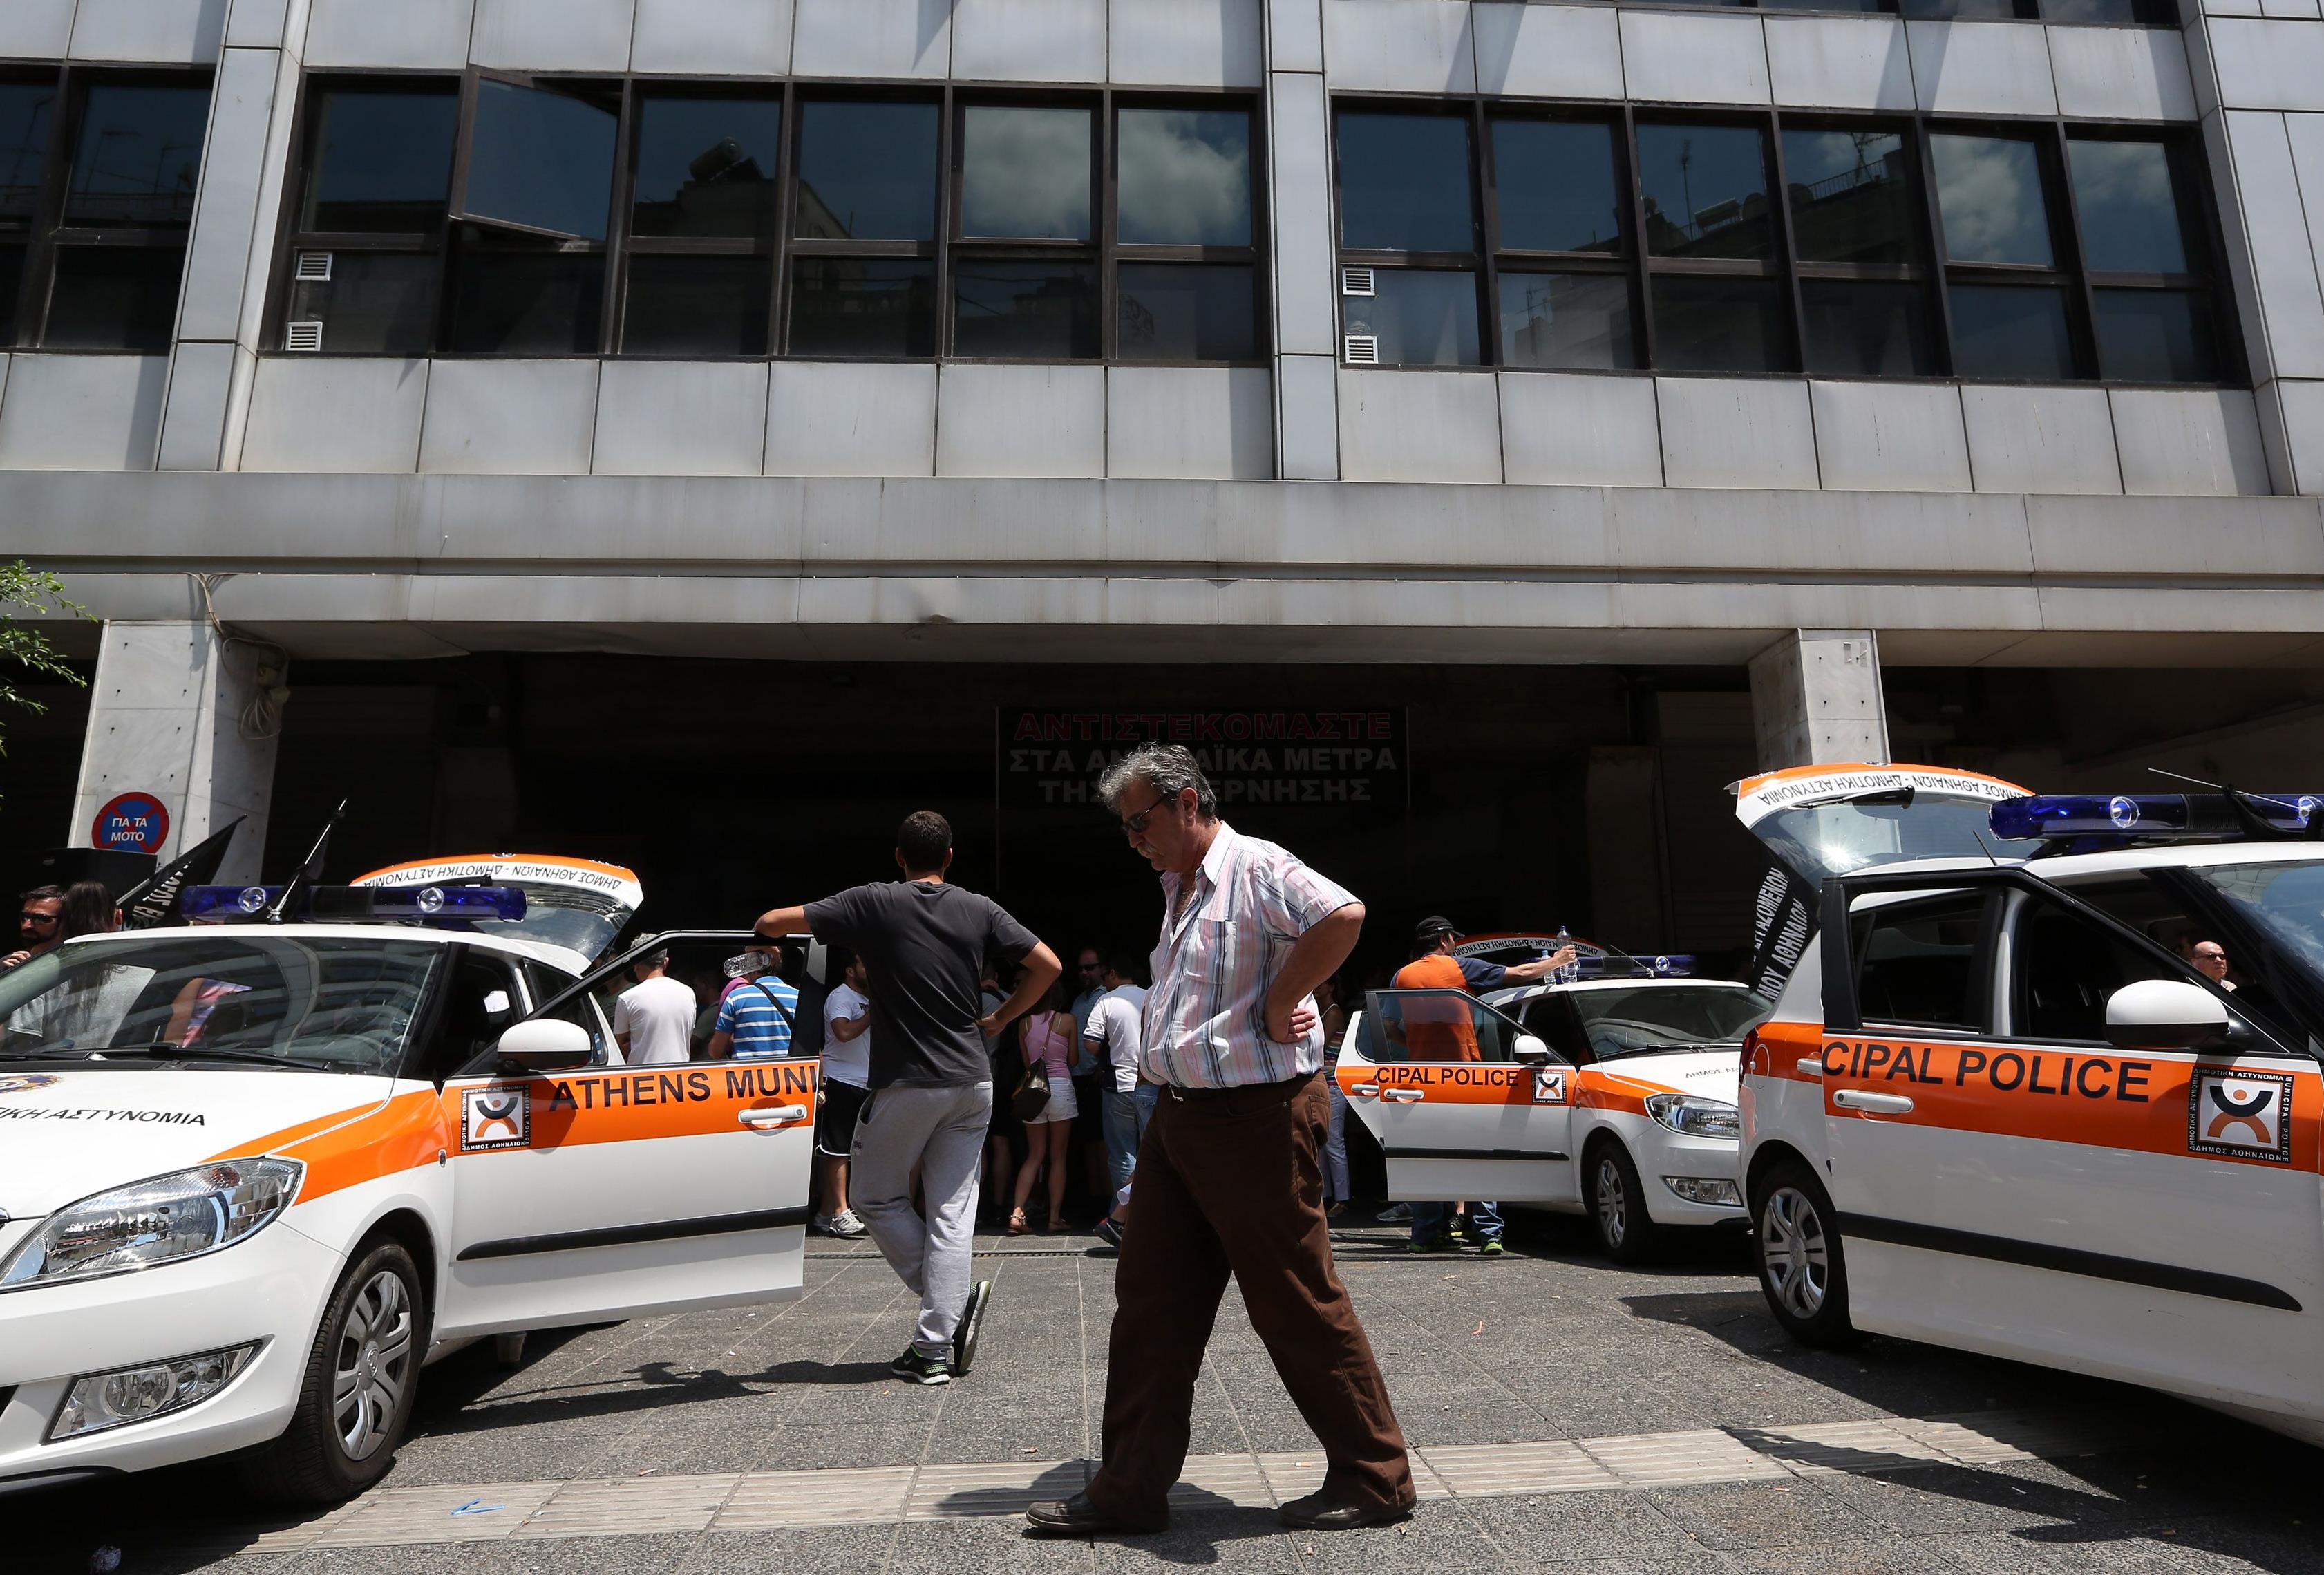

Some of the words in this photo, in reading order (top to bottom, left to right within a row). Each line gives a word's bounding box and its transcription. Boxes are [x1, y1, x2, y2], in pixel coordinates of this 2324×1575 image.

[1013, 713, 1392, 741] ΑΝΤΙΣΤΕΚΟΜΑΣΤΕ
[1010, 749, 1075, 772] ΣΤΑ
[1283, 748, 1397, 771] ΜΕΤΡΑ
[1757, 778, 1833, 805] ΑΣΤΥΝΟΜΙΑ
[1833, 775, 1902, 790] ΔΗΜΟΤΙΚΗ
[1912, 775, 1979, 793] ΑΘΗΝΑΙΩΝ
[112, 818, 129, 827] ΓΙΑ
[133, 818, 147, 827] ΤΑ
[111, 831, 144, 841] ΜΟΤΟ
[437, 865, 503, 877] ΔΗΜΟΤΙΚΗ
[512, 865, 578, 880] ΑΘΗΝΑΙΩΝ
[578, 871, 622, 889] ΔΗΜΟΣ
[1770, 898, 1808, 969] ΑΘΗΝΑΙΩΝ
[1491, 939, 1529, 949] ΔΗΜΟΤΙΚΗ
[1377, 1066, 1436, 1084] CIPAL
[1441, 1068, 1519, 1086] POLICE
[1822, 1041, 1943, 1084] CIPAL
[1956, 1050, 2153, 1103] POLICE
[2193, 1068, 2233, 1077] ΔΗΜΟΤΙΚΗ
[2237, 1073, 2284, 1082] ΑΣΤΥΝΟΜΙΑ
[549, 1073, 711, 1112] ATHENS
[726, 1066, 817, 1099] MUNI
[2190, 1073, 2199, 1111] ΑΣΤΥΝΟΜΙΑ
[2282, 1076, 2292, 1123] MUNICIPAL
[44, 1109, 205, 1126] ΑΣΤΥΝΟΜΙΑ
[2195, 1144, 2227, 1155] ΔΗΜΟΣ
[2231, 1149, 2282, 1161] ΑΘΗΝΑΙΩΝ
